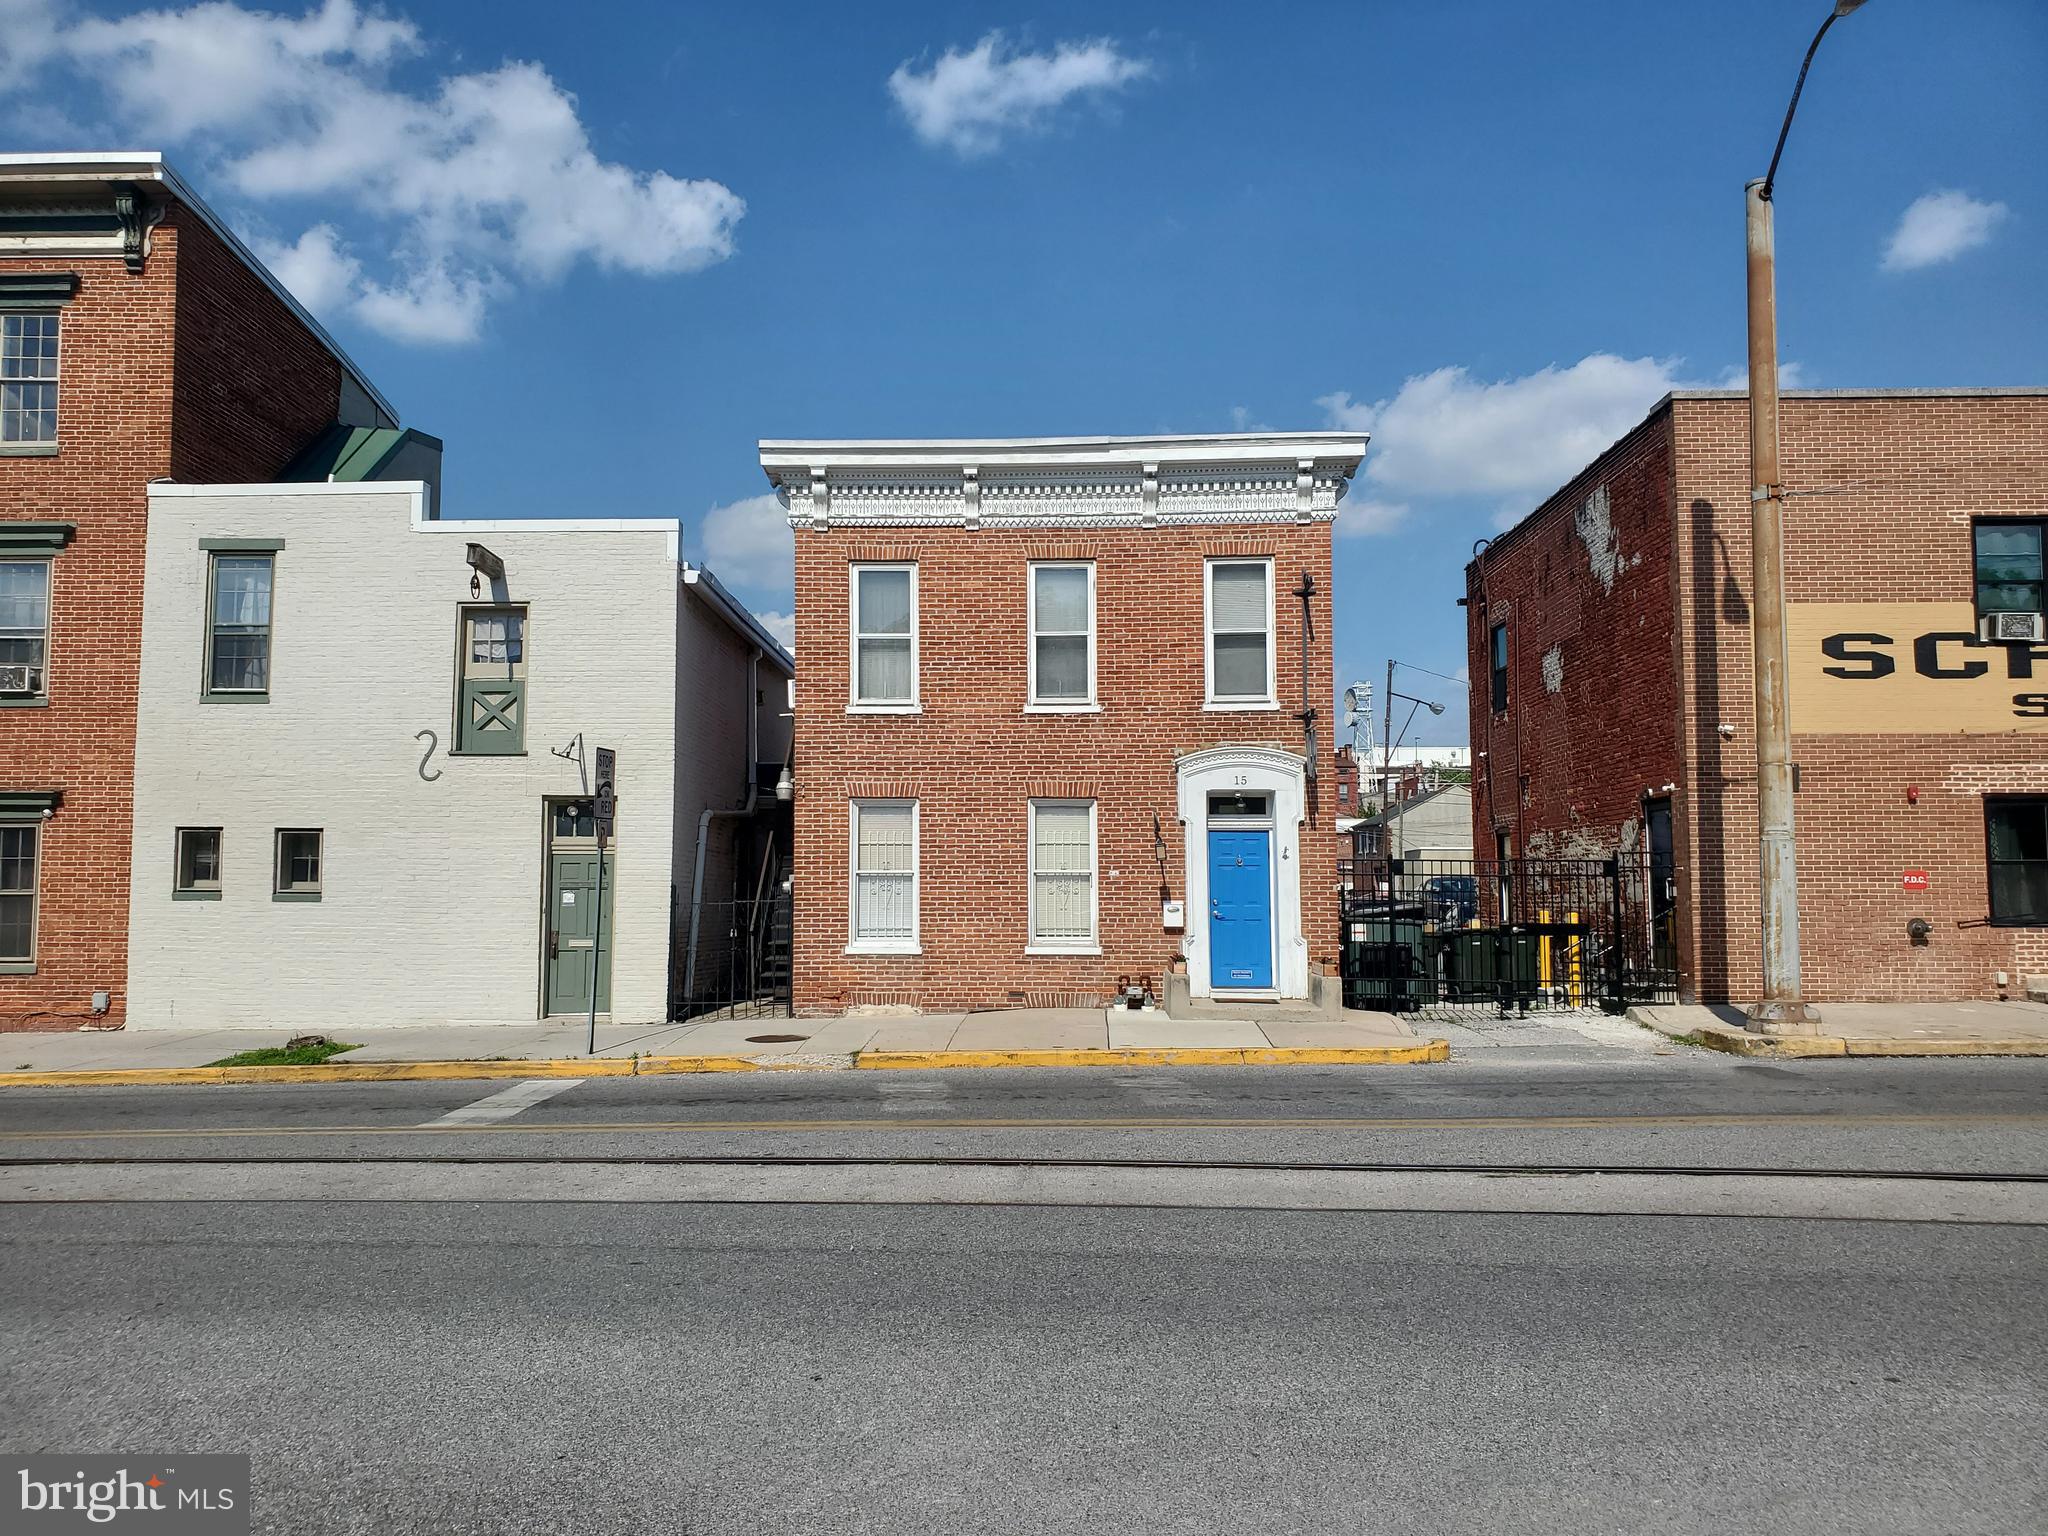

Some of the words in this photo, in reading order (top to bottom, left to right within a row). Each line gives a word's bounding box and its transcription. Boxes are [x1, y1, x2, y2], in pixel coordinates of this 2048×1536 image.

[599, 754, 613, 769] STOP
[1234, 775, 1248, 785] 15
[601, 800, 612, 814] RED
